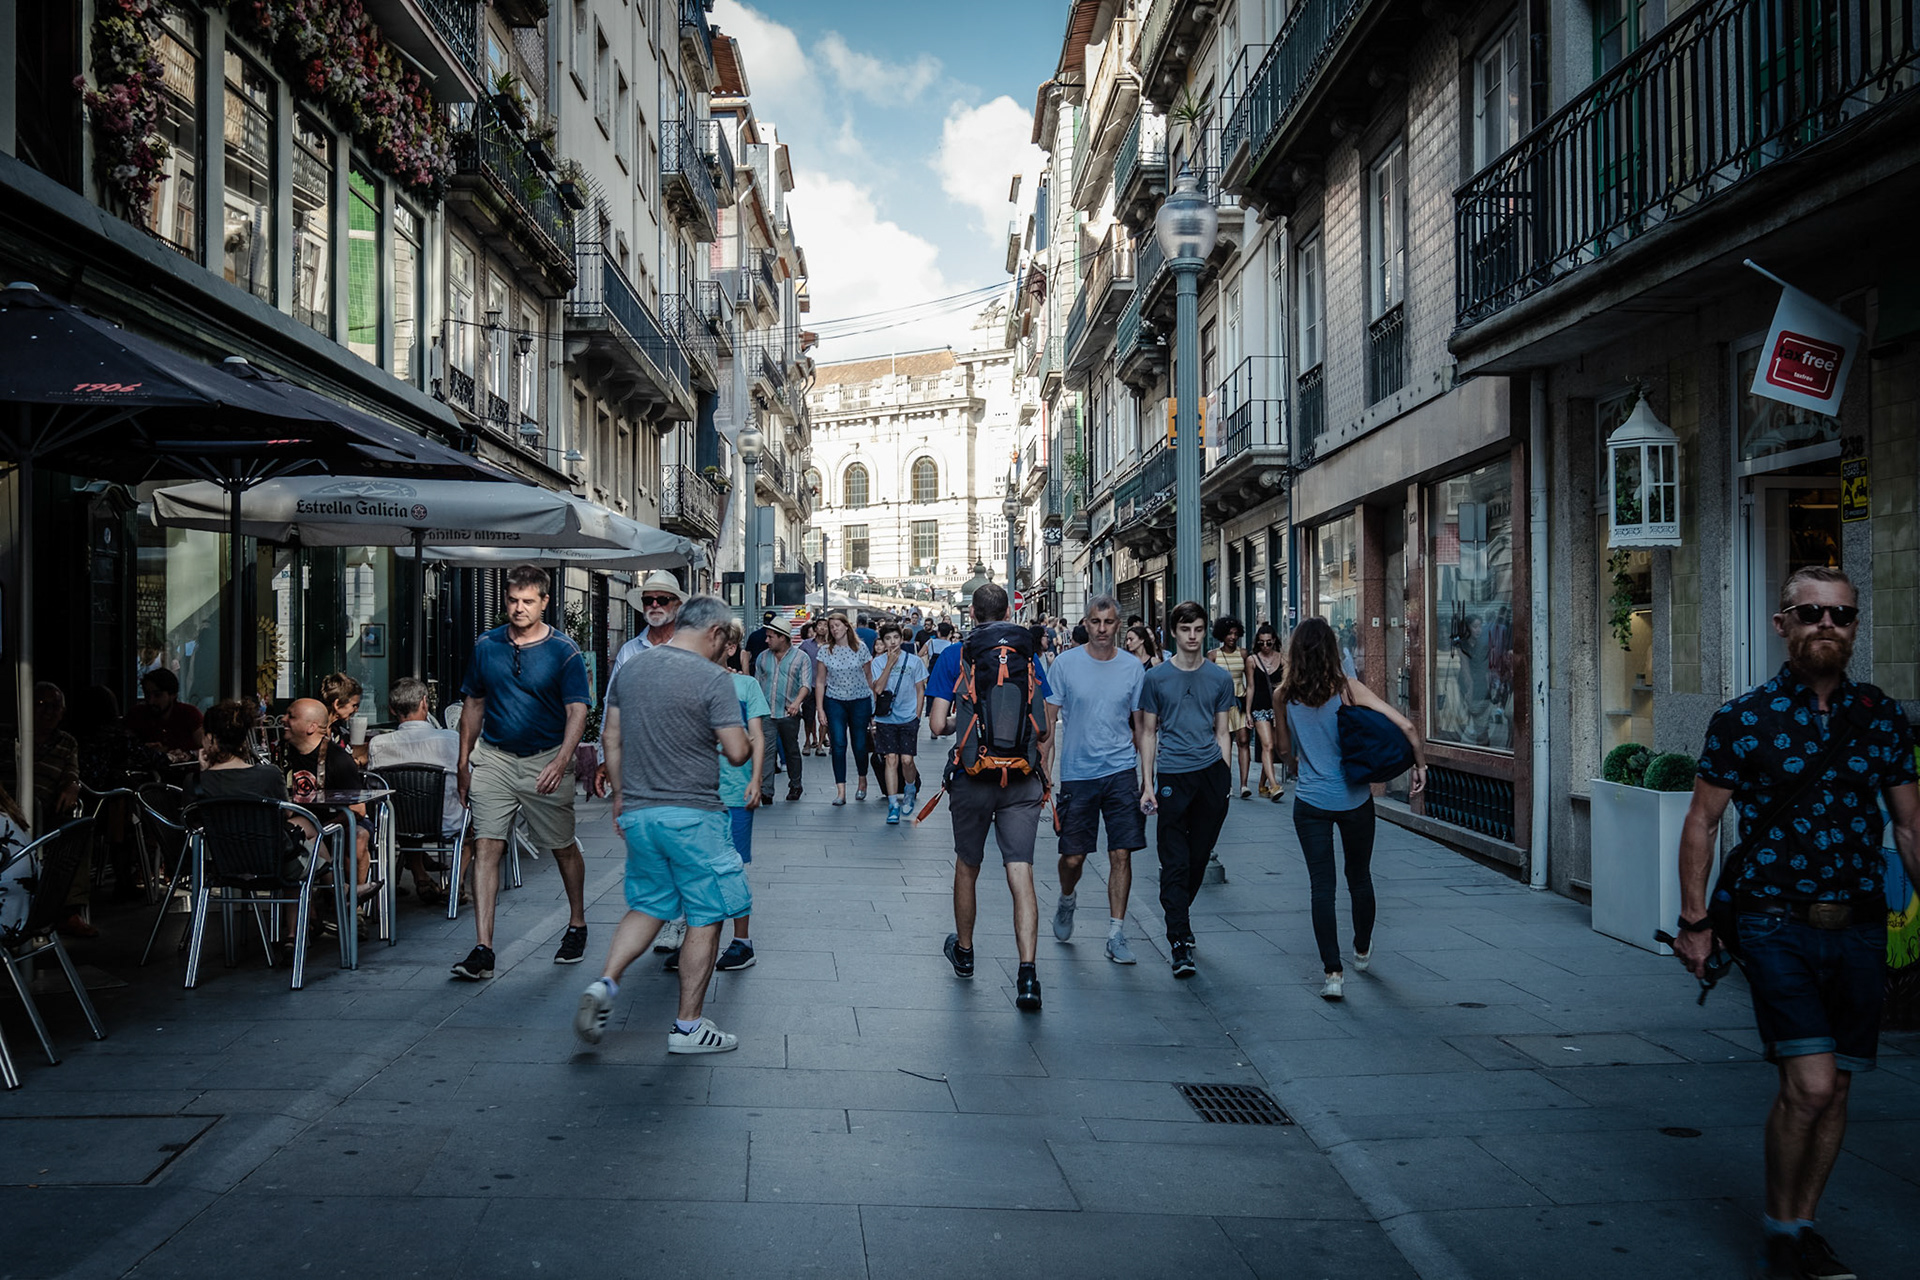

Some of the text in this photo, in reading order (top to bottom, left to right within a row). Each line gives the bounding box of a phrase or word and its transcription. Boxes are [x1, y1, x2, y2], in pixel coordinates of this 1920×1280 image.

[1778, 345, 1835, 372] taxfree
[72, 382, 143, 393] 1906
[296, 500, 408, 518] Estrella Galicia
